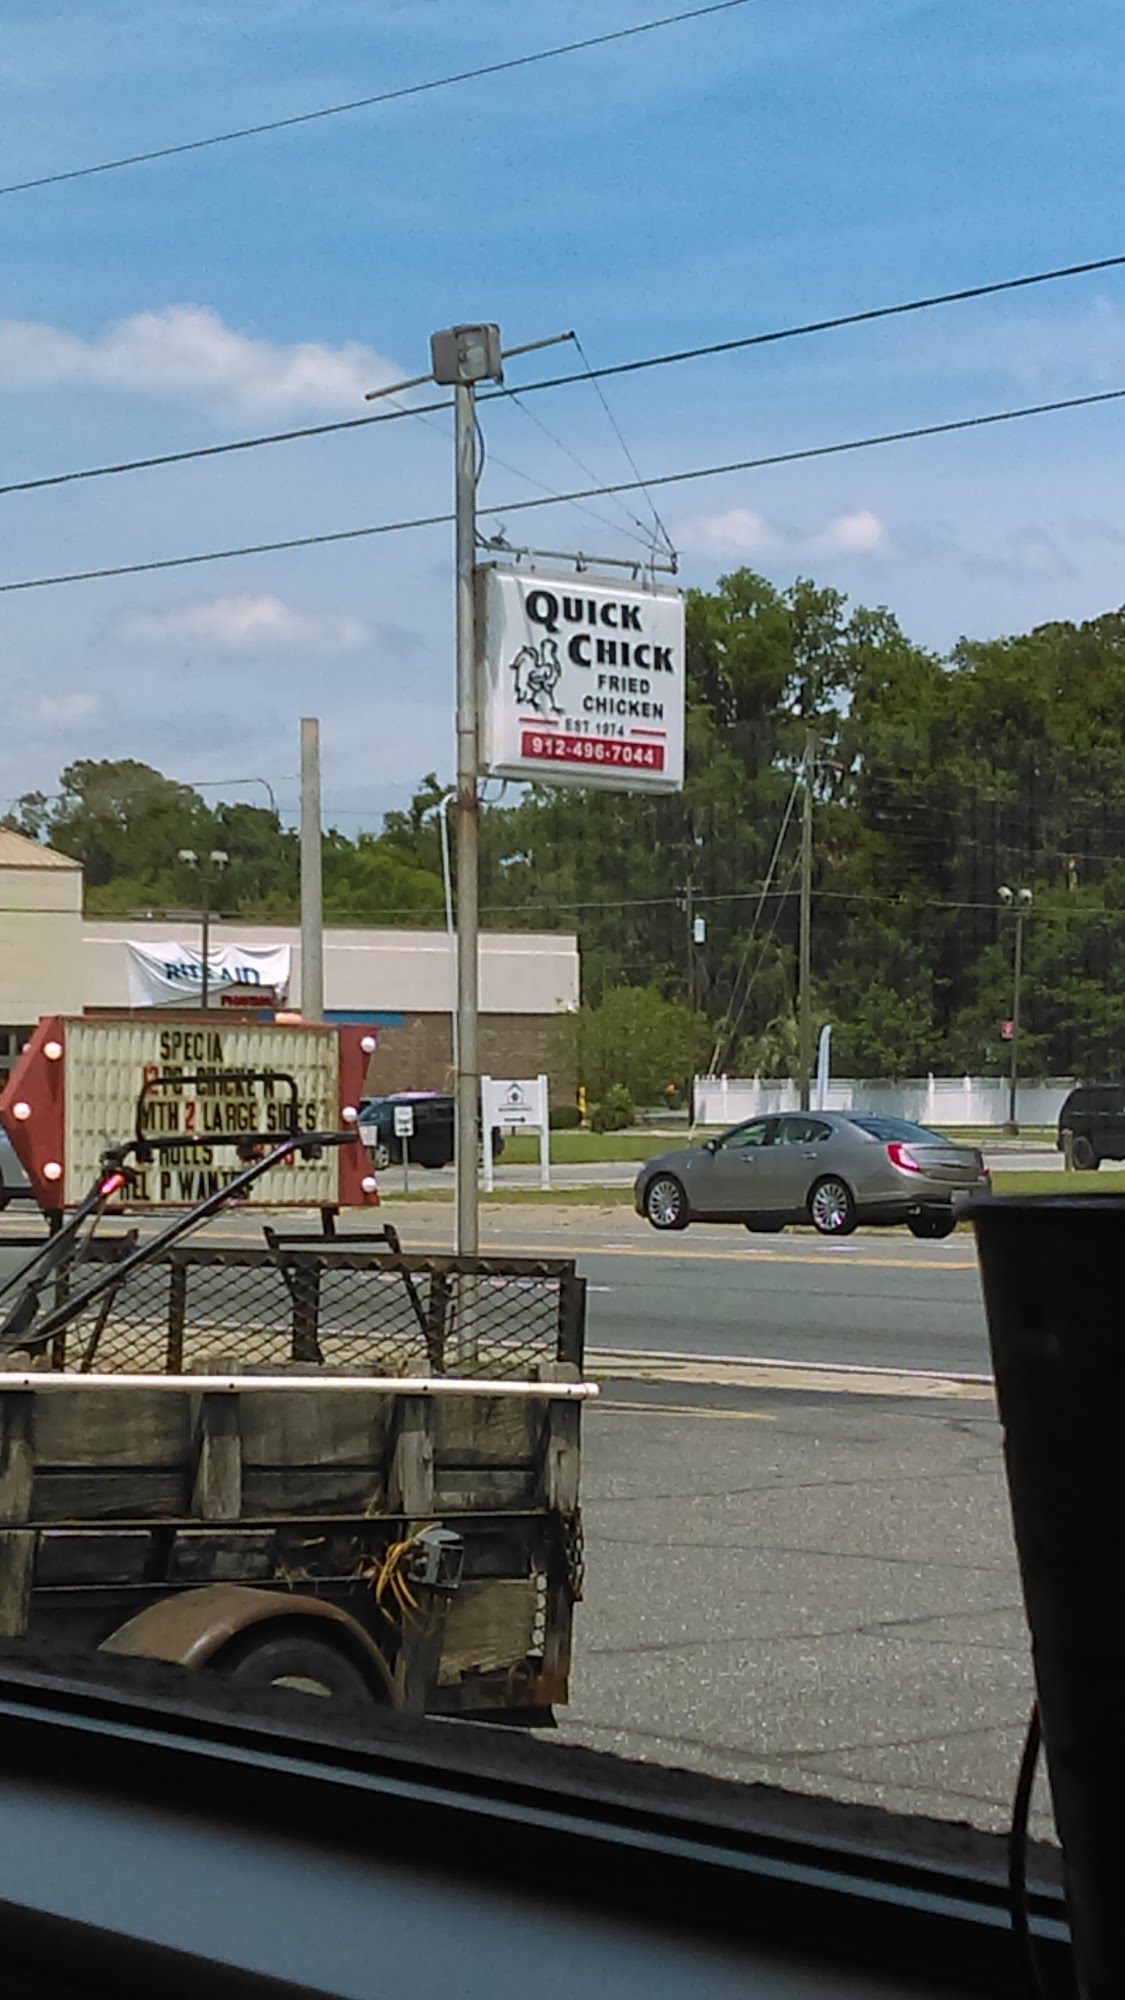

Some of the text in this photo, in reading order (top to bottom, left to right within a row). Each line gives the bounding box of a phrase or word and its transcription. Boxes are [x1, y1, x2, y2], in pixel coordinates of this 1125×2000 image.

[525, 590, 643, 633] QUICK
[568, 634, 675, 674] CHICK
[597, 674, 651, 694] FRIED
[582, 695, 664, 720] CHICKEN
[531, 737, 655, 764] 912-496-7044
[160, 1031, 224, 1063] SPECIA
[185, 1101, 195, 1131] 2
[203, 1102, 258, 1131] LARGE
[266, 1103, 317, 1132] SIDES
